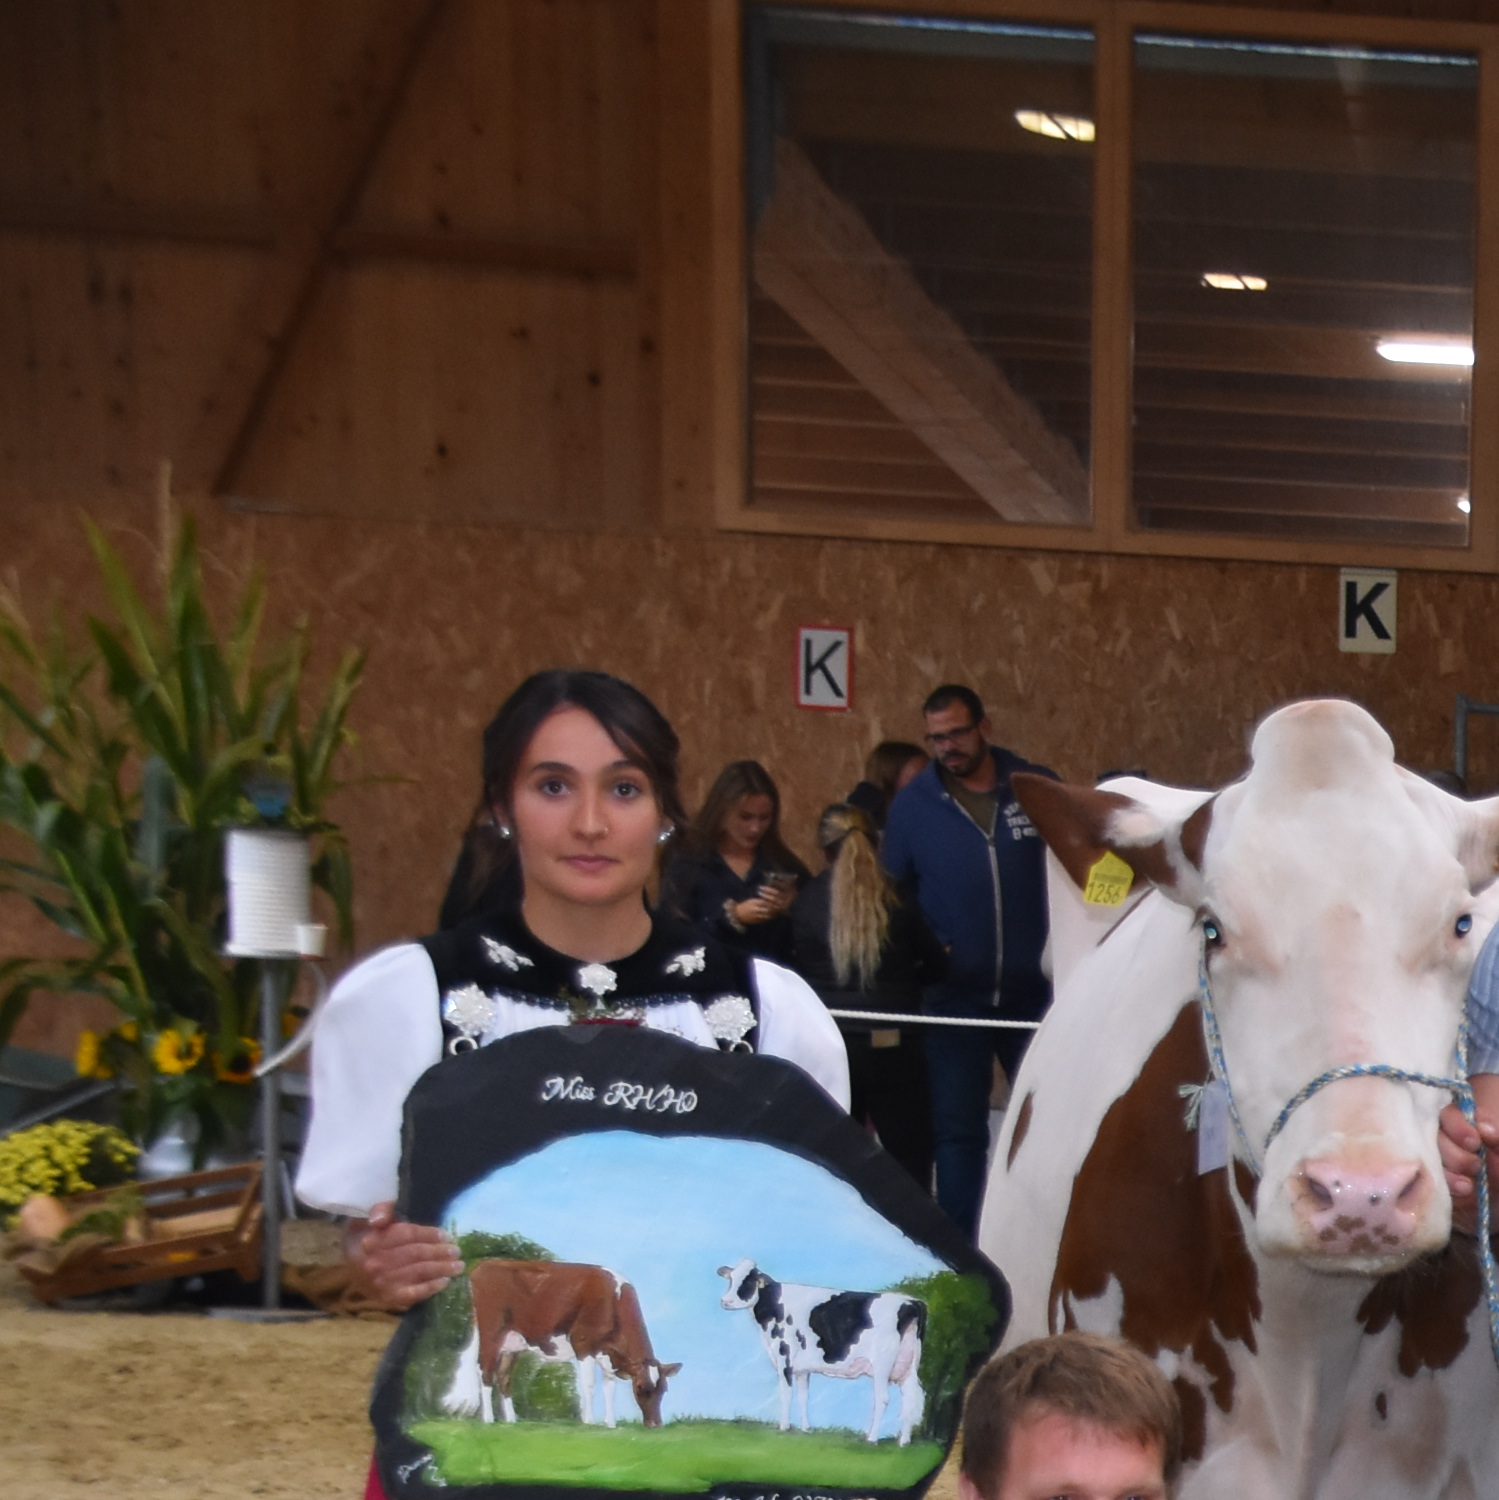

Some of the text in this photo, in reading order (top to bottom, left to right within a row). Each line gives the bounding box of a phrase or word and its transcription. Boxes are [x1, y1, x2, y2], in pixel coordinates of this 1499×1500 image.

[1344, 580, 1392, 640] K
[803, 638, 844, 698] K
[541, 1076, 595, 1101] Miss
